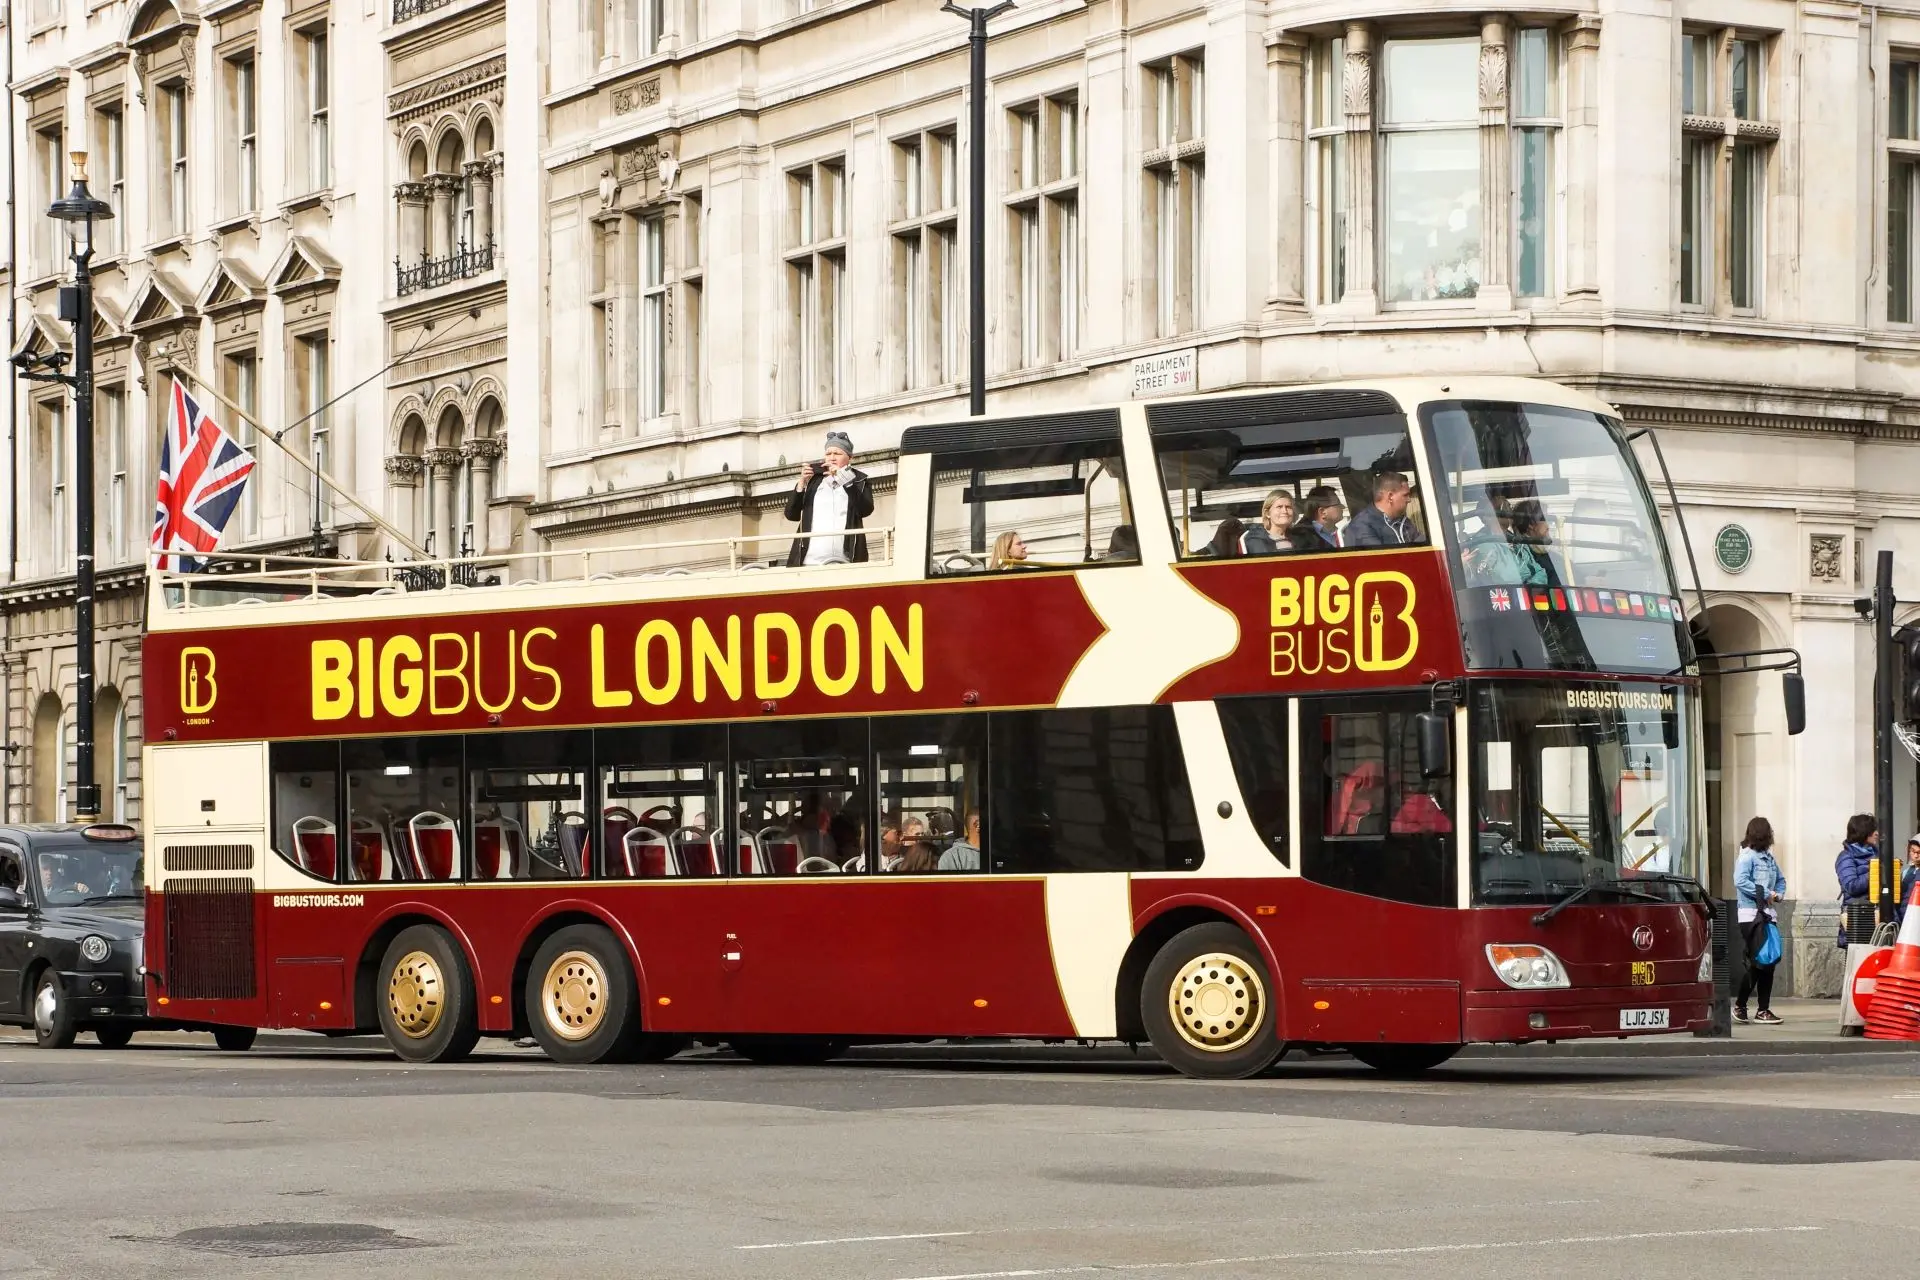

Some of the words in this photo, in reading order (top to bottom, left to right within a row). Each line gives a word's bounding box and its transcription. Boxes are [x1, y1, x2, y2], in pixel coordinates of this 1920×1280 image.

[1134, 354, 1191, 376] PARLIAMENT
[1135, 374, 1168, 391] STREET
[1173, 371, 1192, 384] SW1
[1271, 574, 1350, 627] BIG
[590, 603, 924, 708] LONDON
[1271, 628, 1350, 676] BUS
[1566, 690, 1673, 711] BIGBUSTOURS.COM
[273, 894, 364, 907] BIGBUSTOURS.COM
[1632, 962, 1645, 974] BIG
[1632, 974, 1645, 986] BUS
[1626, 1011, 1646, 1026] LJ12
[1649, 1011, 1665, 1025] JSX
